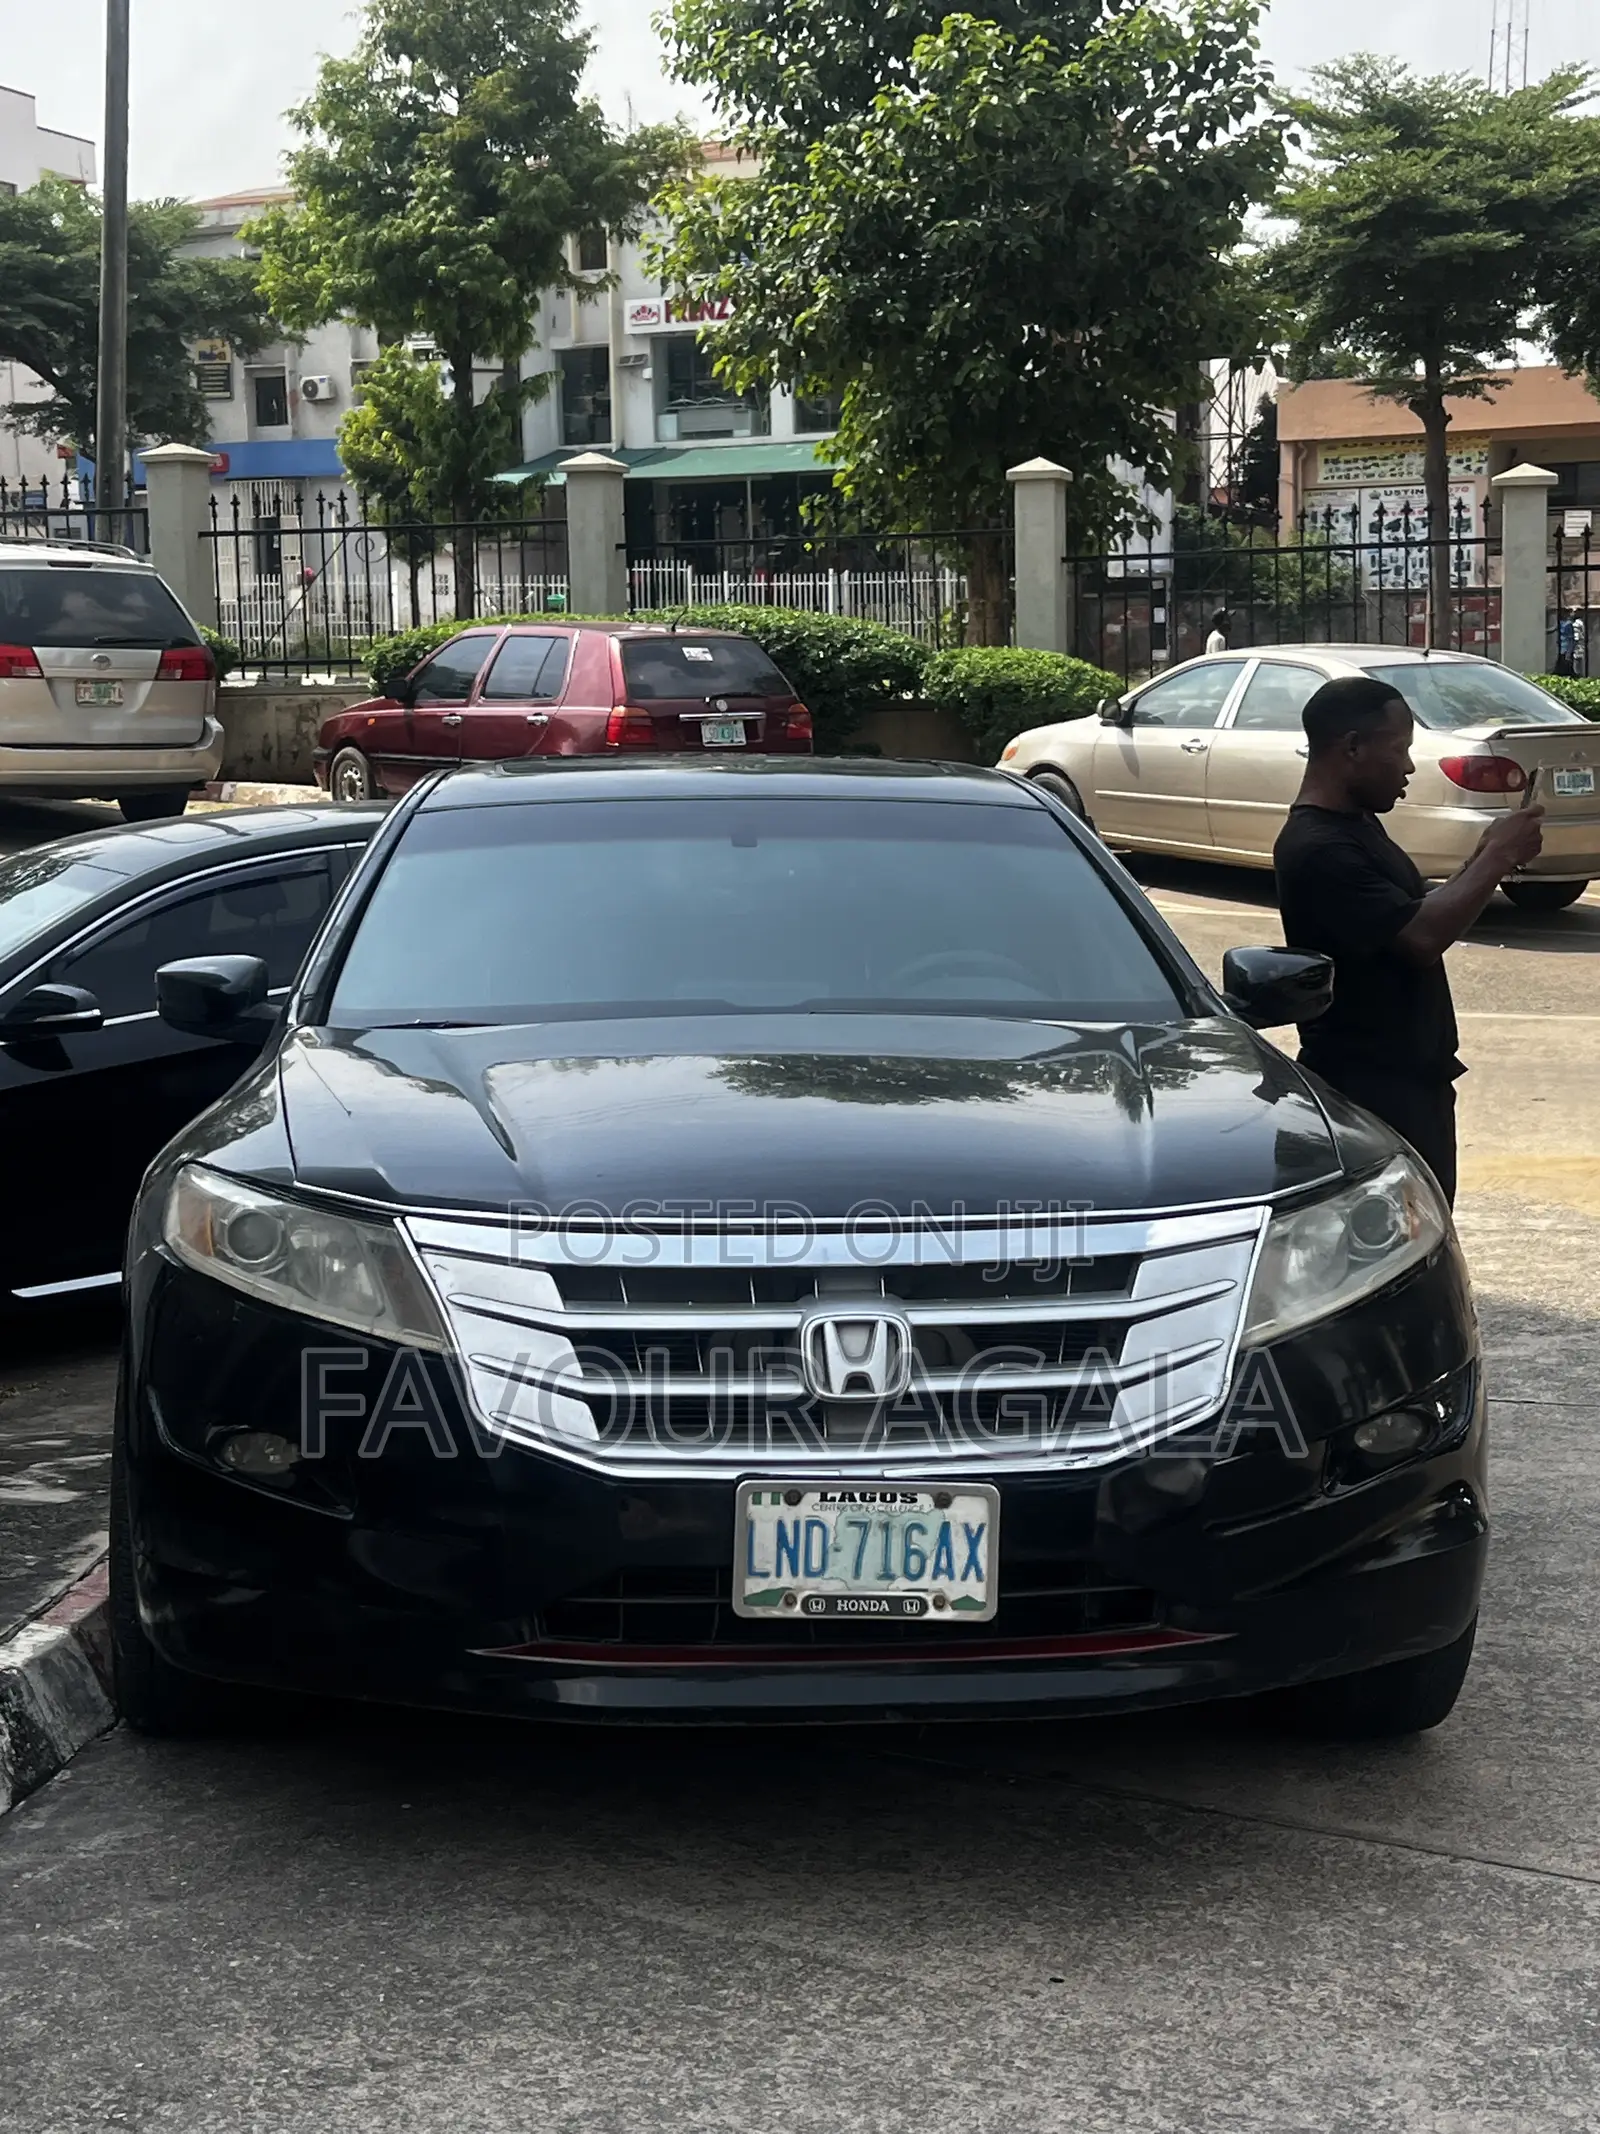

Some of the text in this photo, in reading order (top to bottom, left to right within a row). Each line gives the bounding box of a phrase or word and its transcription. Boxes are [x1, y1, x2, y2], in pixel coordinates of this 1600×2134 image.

[818, 1491, 918, 1504] LAGOS
[811, 1503, 847, 1512] CENTRE
[747, 1515, 986, 1583] LND-716AX
[836, 1599, 890, 1612] HONDA
